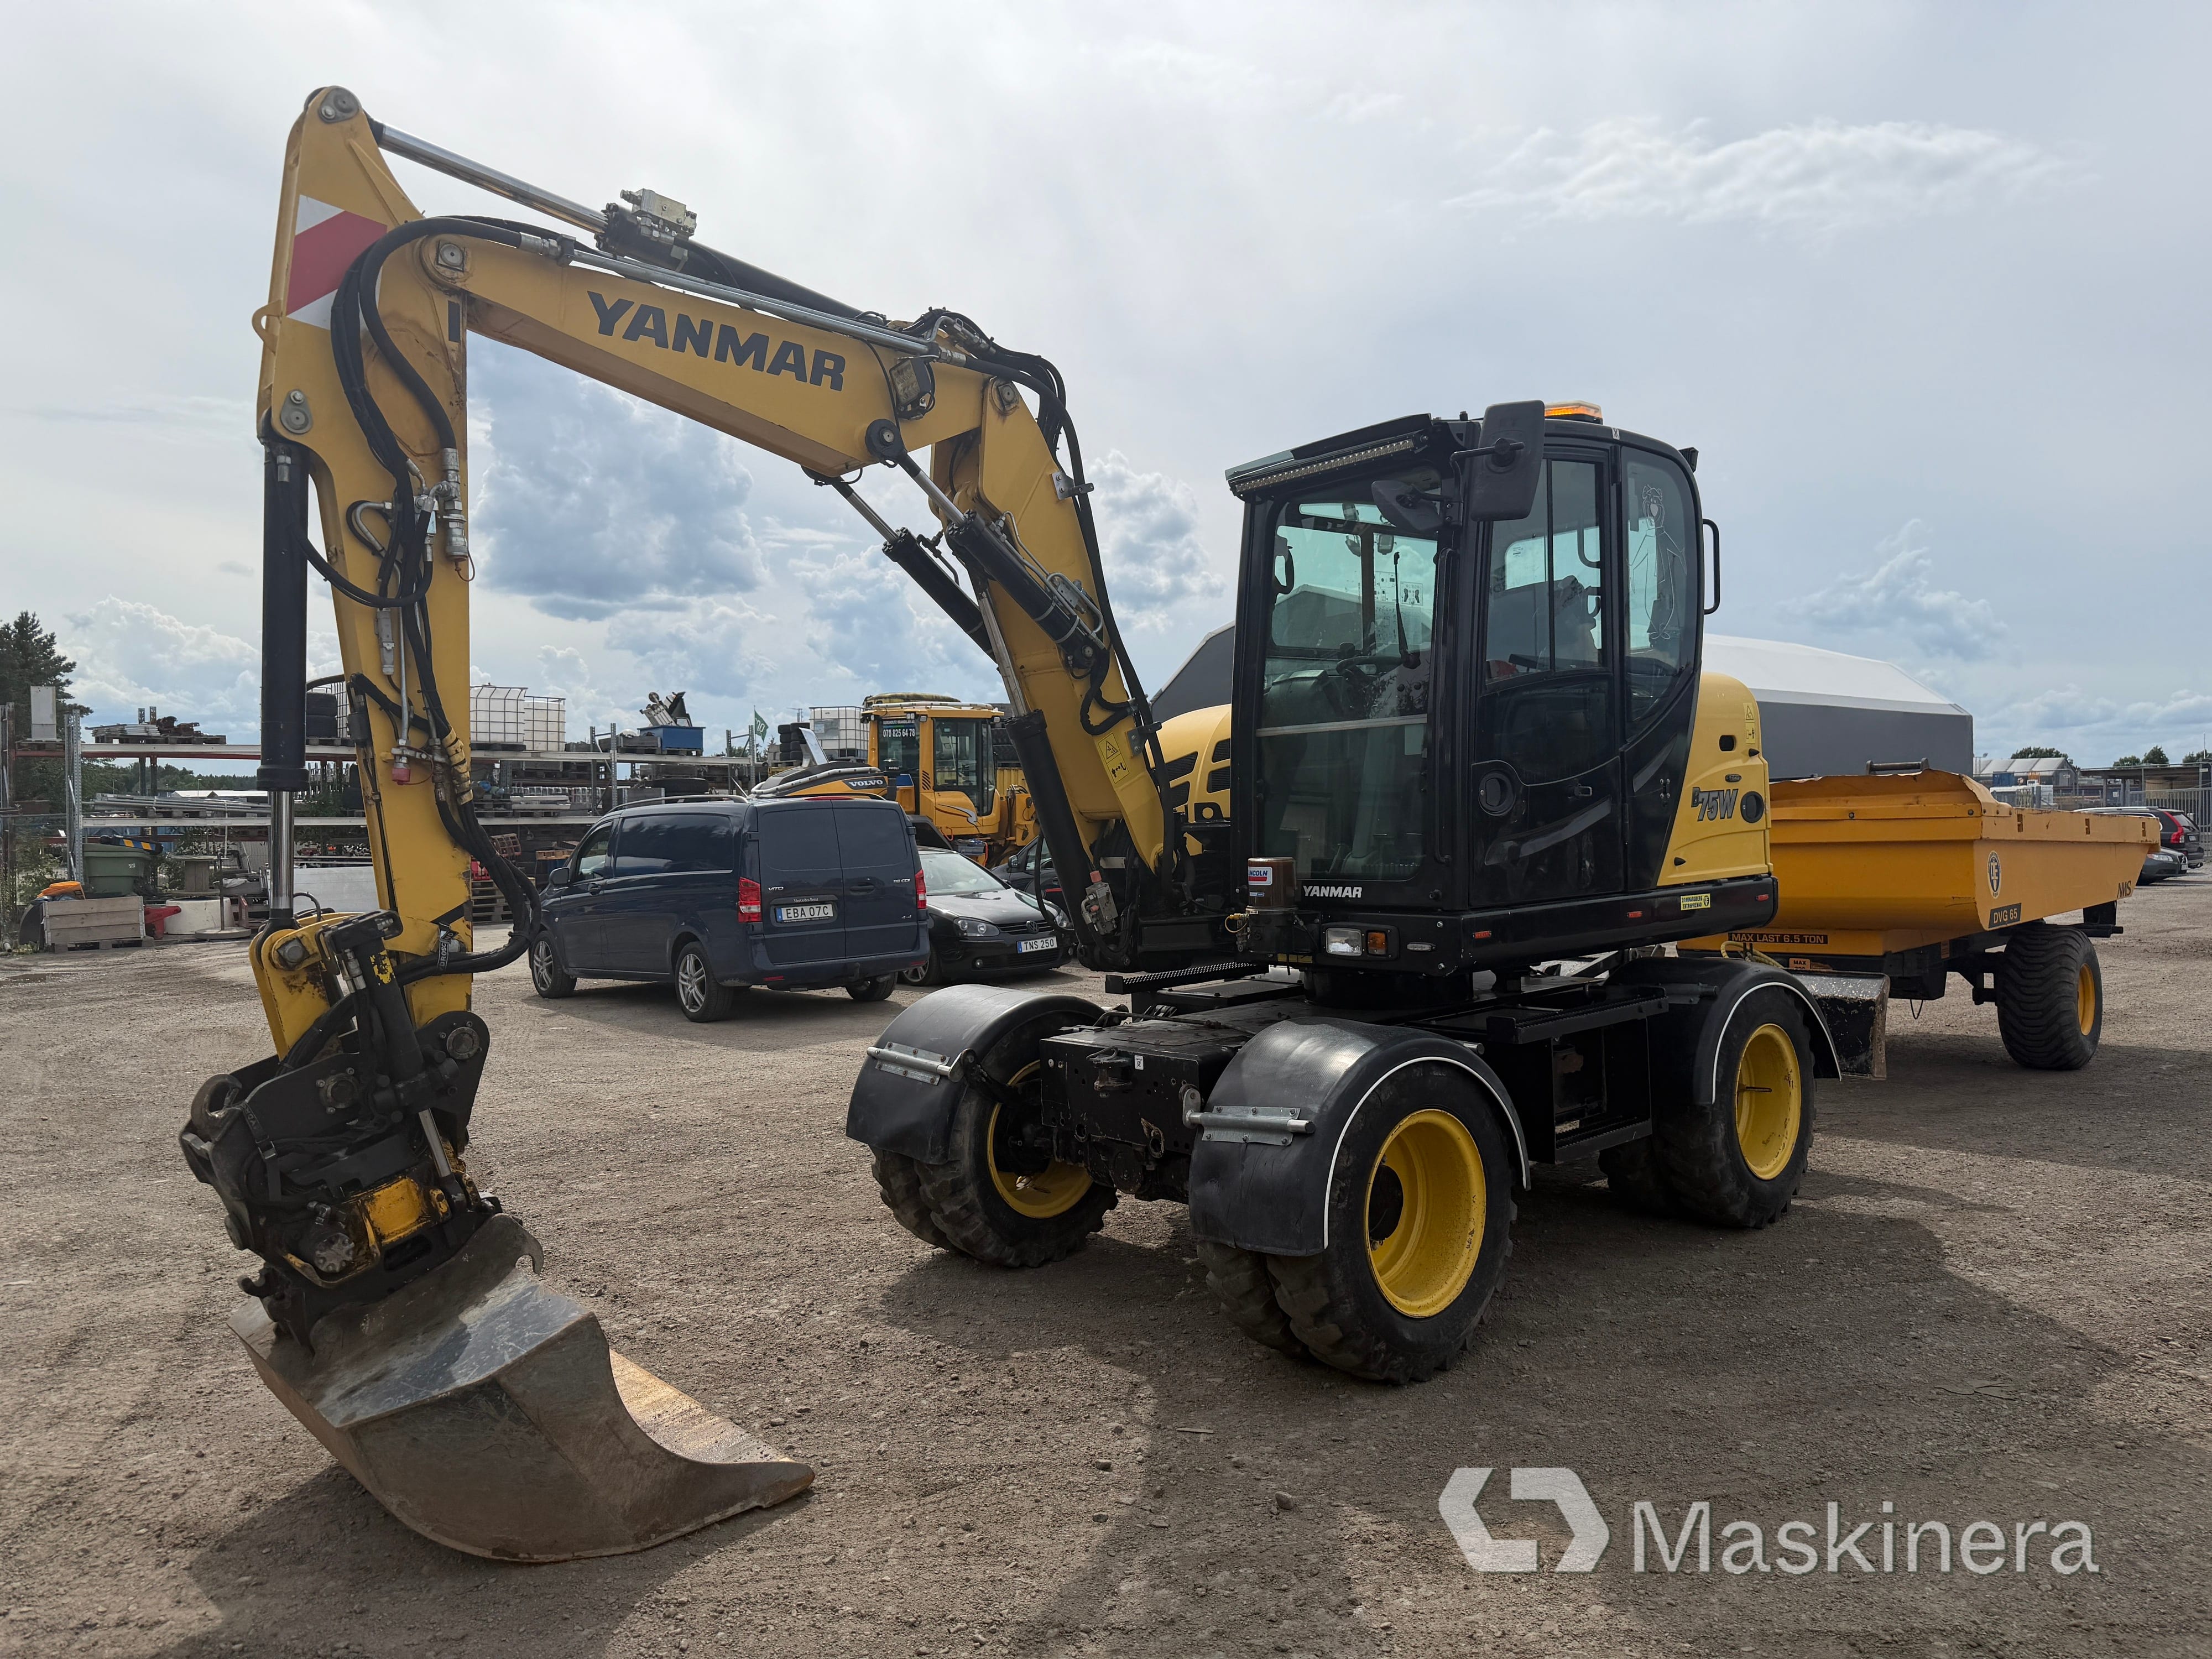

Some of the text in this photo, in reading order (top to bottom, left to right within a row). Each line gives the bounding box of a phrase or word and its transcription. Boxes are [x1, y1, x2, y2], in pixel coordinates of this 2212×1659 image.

[587, 290, 846, 392] YANMAR
[883, 728, 915, 737] 070 825 64 78
[1303, 885, 1362, 898] YANMAR
[786, 906, 828, 919] EBA 07C
[1994, 907, 2018, 924] DVG 65
[1024, 938, 1054, 950] TNS 250
[1731, 933, 1824, 943] MAX LAST 6.5 TON
